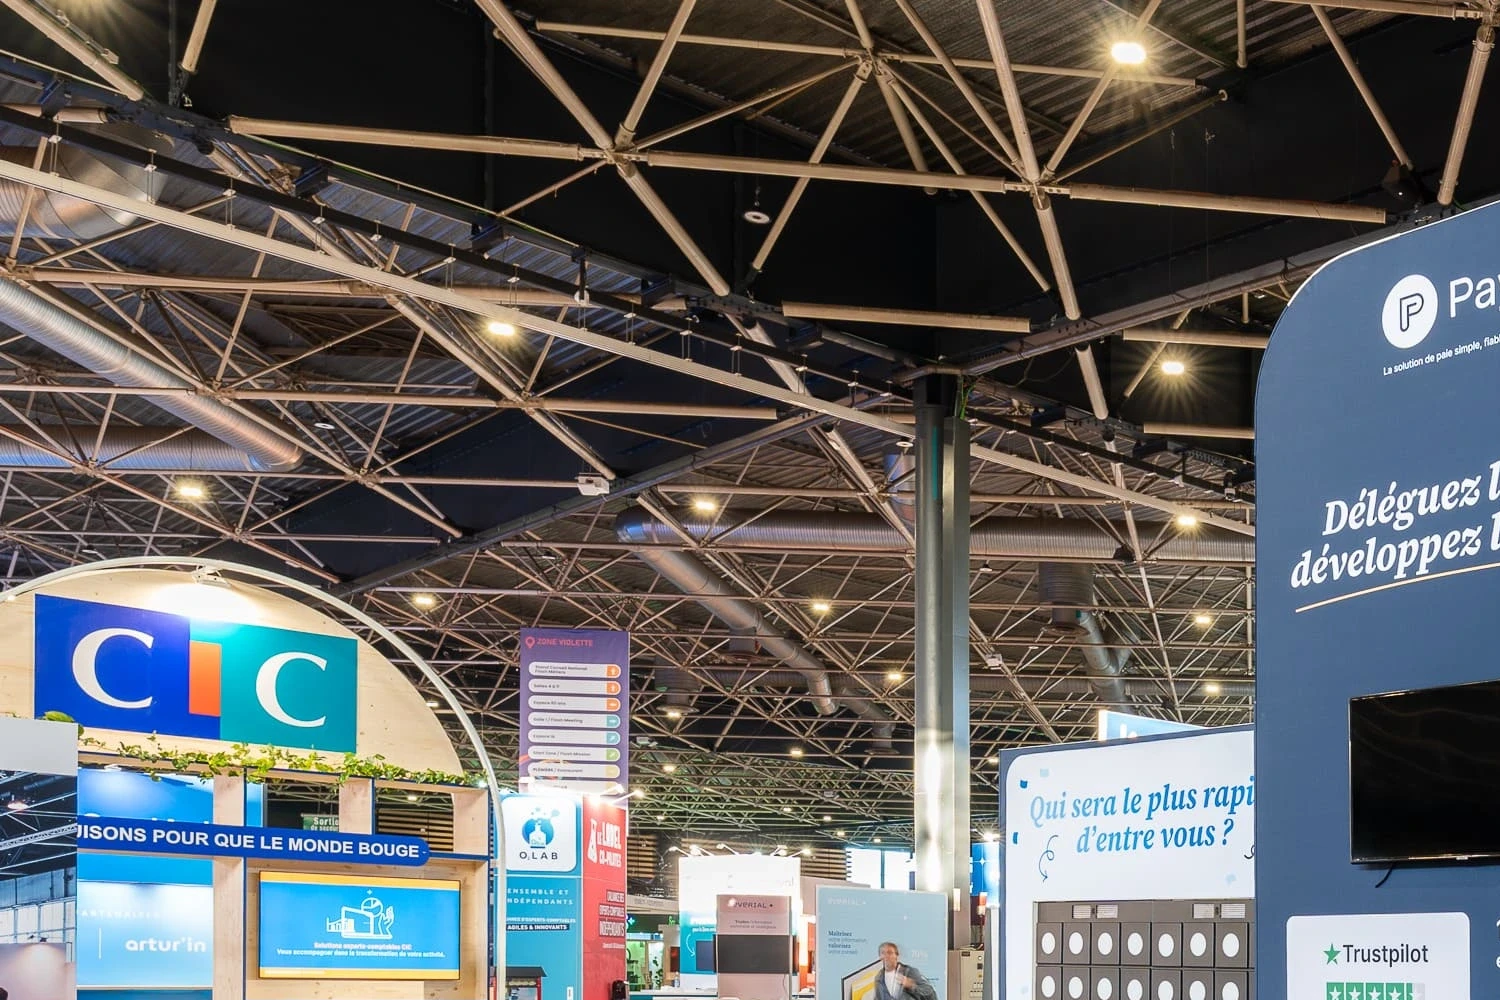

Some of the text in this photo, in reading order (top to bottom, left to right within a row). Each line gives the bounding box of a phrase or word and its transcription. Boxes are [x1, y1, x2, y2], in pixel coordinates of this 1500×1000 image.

[1383, 366, 1393, 376] La
[1393, 356, 1423, 373] solution
[1424, 353, 1435, 364] de
[1436, 346, 1453, 363] paie
[1454, 340, 1483, 356] simple,
[1321, 475, 1481, 536] Déléguez
[1290, 524, 1483, 588] développez
[536, 638, 594, 647] ZONE VIOLETTE
[72, 628, 327, 728] CIC
[1030, 791, 1067, 828] Qui
[1071, 795, 1117, 818] sera
[1123, 787, 1142, 815] le
[1145, 783, 1197, 820] plus
[152, 829, 209, 846] POUR
[214, 833, 255, 848] QUE
[260, 837, 283, 851] LE
[289, 838, 353, 854] MONDE
[359, 843, 419, 858] BOUGE
[1076, 818, 1234, 853] d'entre vous ?
[125, 937, 207, 952] artur'in
[1343, 943, 1429, 968] Trustpilot
